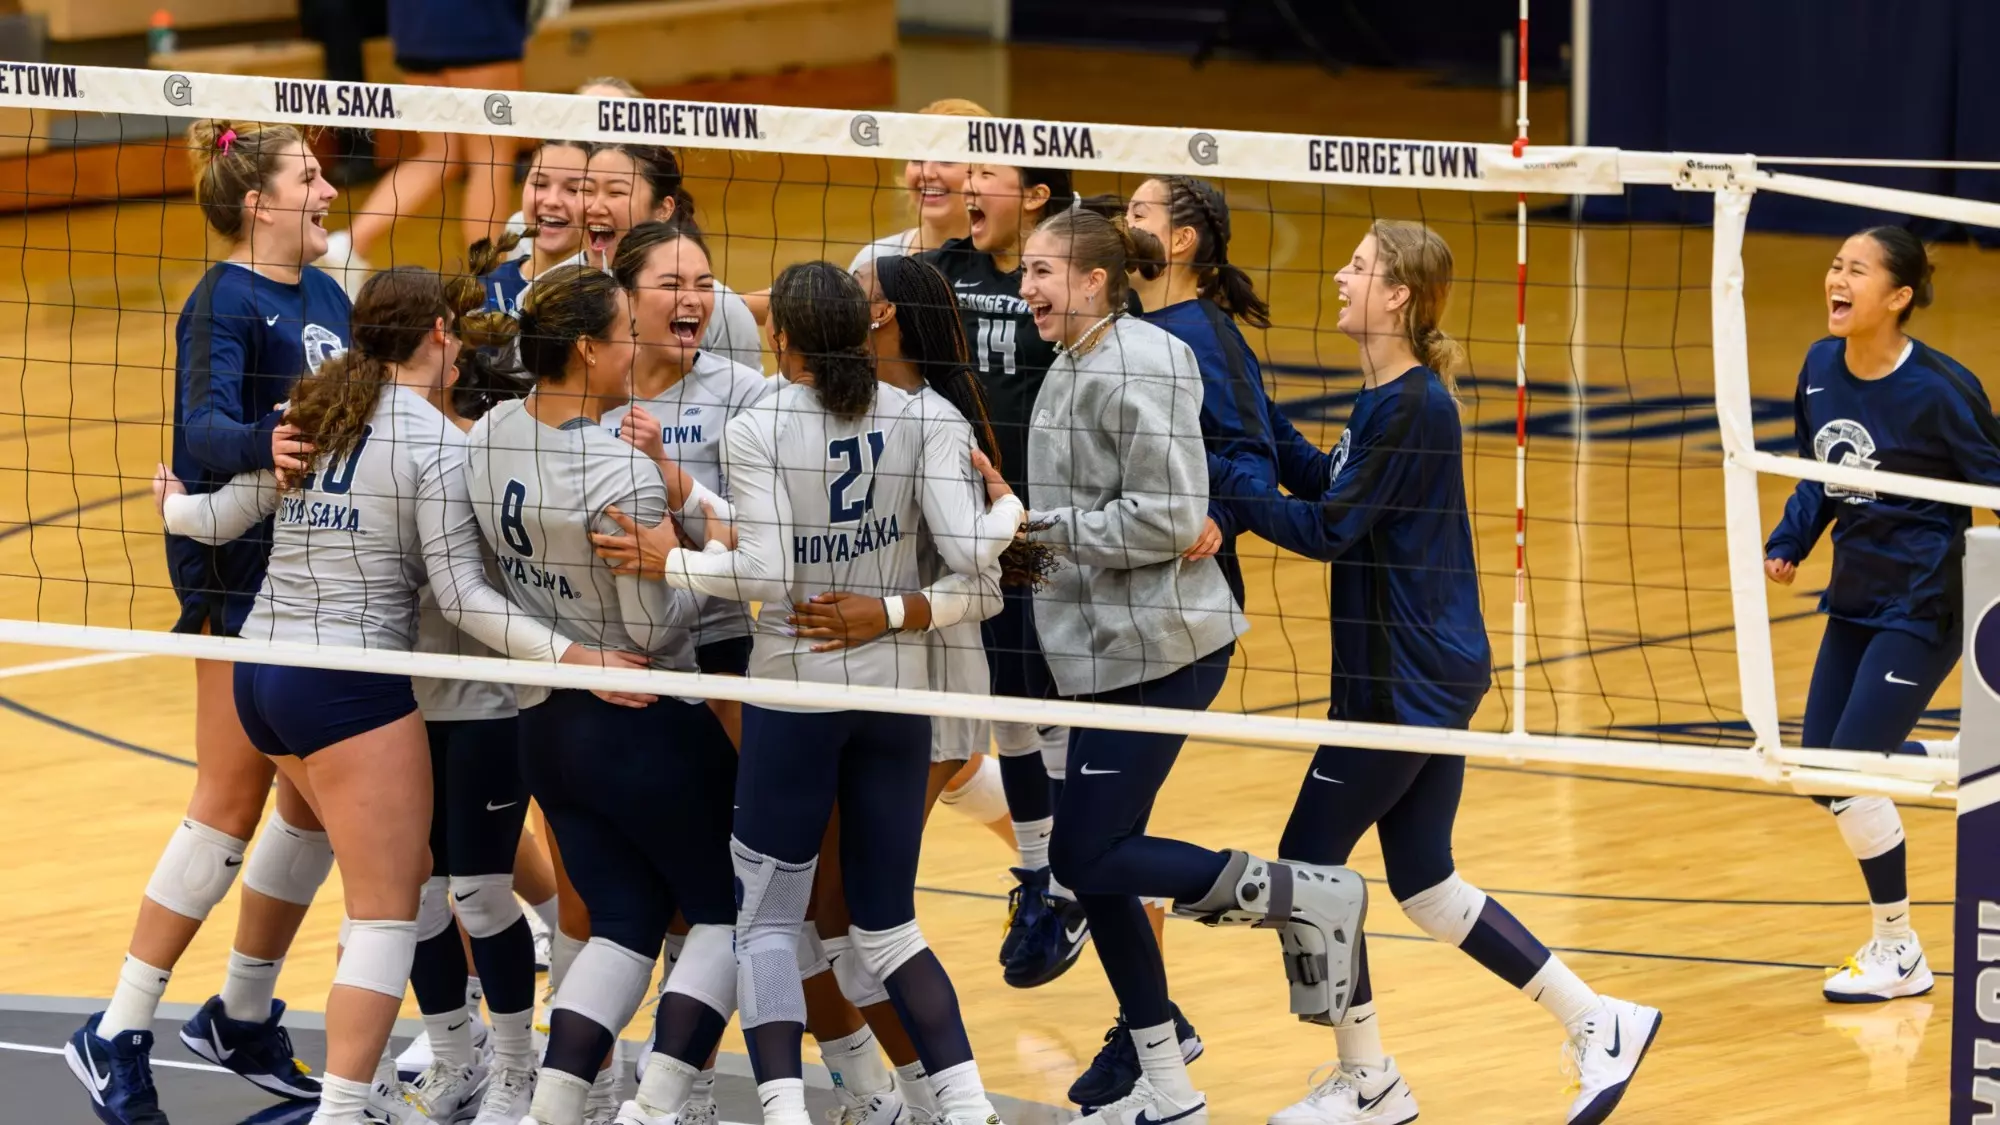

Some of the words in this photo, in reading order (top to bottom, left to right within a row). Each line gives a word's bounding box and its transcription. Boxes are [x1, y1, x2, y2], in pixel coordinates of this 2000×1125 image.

[275, 81, 331, 116] HOYA
[337, 85, 396, 119] SAXA
[599, 99, 760, 140] GEORGETOWN
[967, 120, 1026, 156] HOYA
[1033, 124, 1095, 159] SAXA
[1309, 139, 1479, 179] GEORGETOWN
[956, 292, 1032, 314] EORGETO
[977, 317, 1016, 374] 14
[828, 430, 885, 523] 21
[280, 497, 305, 524] OYA
[310, 502, 360, 532] SAXA
[500, 477, 535, 558] 8
[793, 533, 850, 564] HOYA
